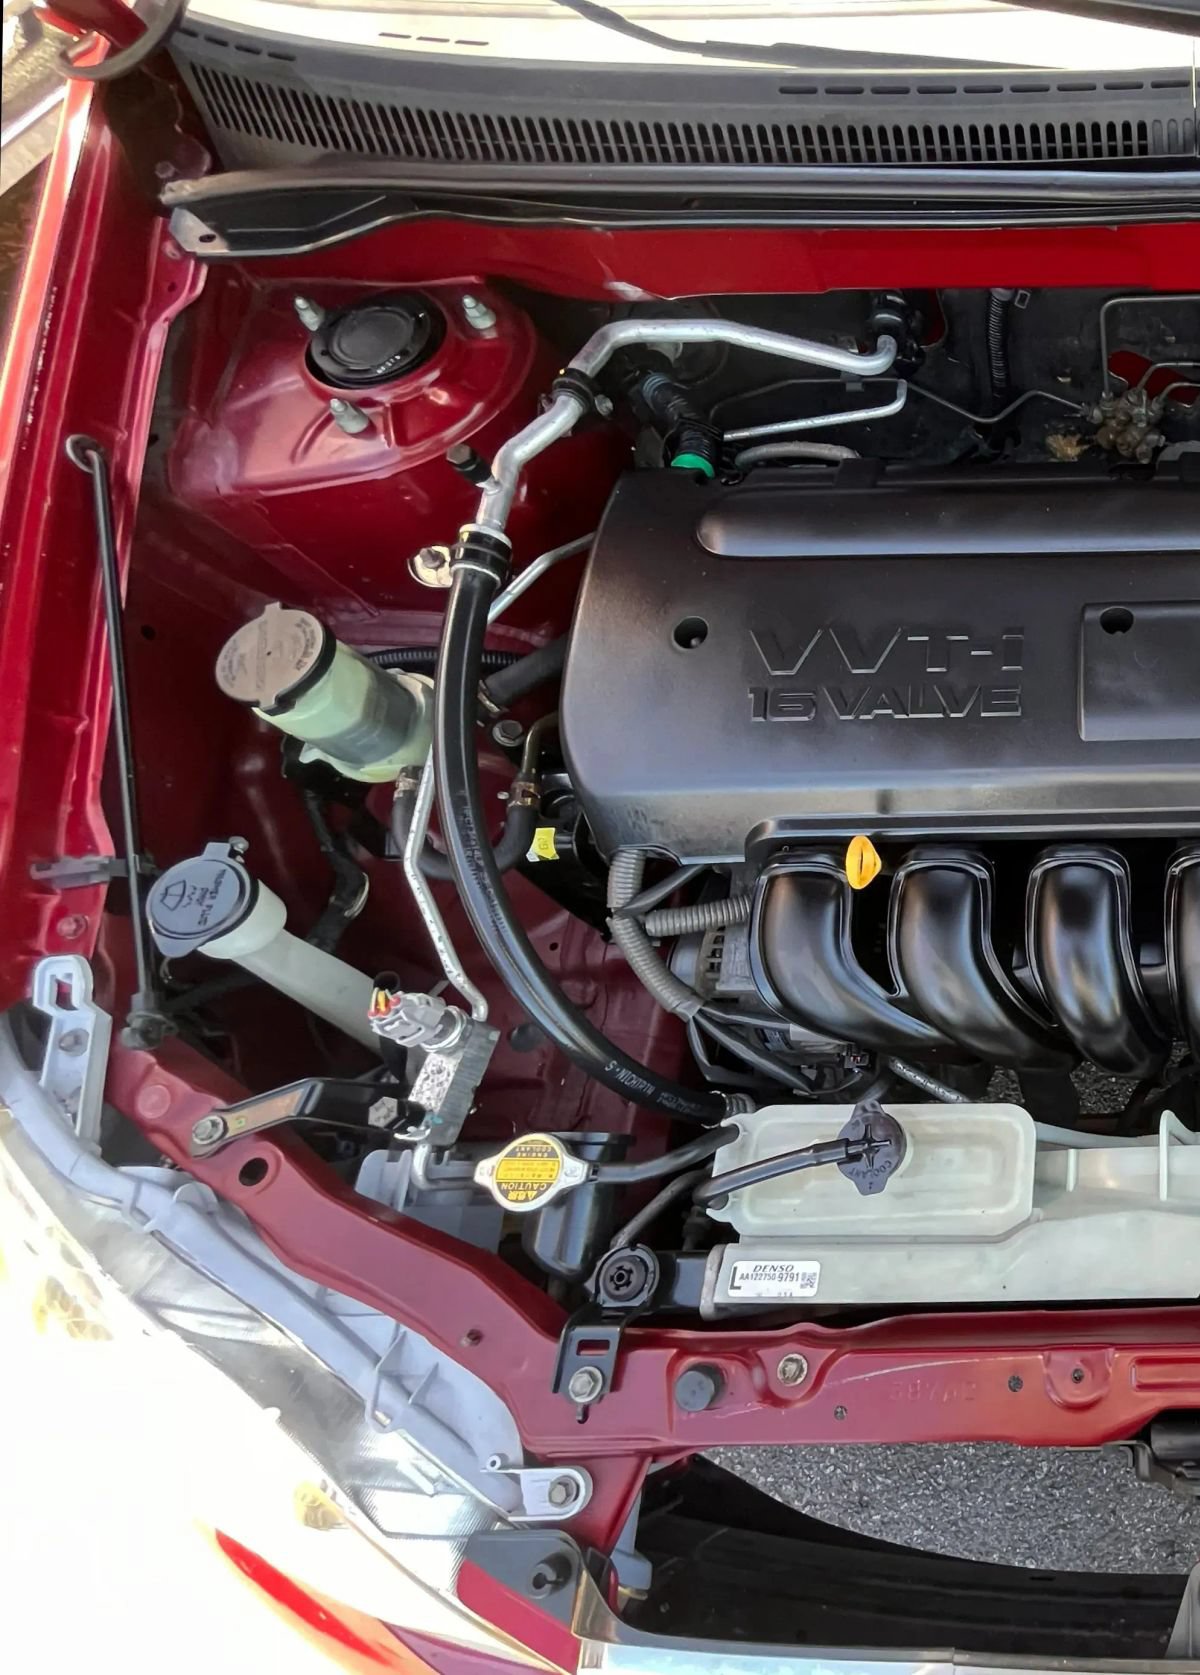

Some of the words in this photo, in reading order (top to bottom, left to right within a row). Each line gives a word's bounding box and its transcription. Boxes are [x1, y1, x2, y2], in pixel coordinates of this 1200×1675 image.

[748, 686, 817, 722] 16
[821, 684, 1022, 721] VALVE
[500, 1182, 547, 1190] CAUTION
[753, 1264, 795, 1272] DENSO
